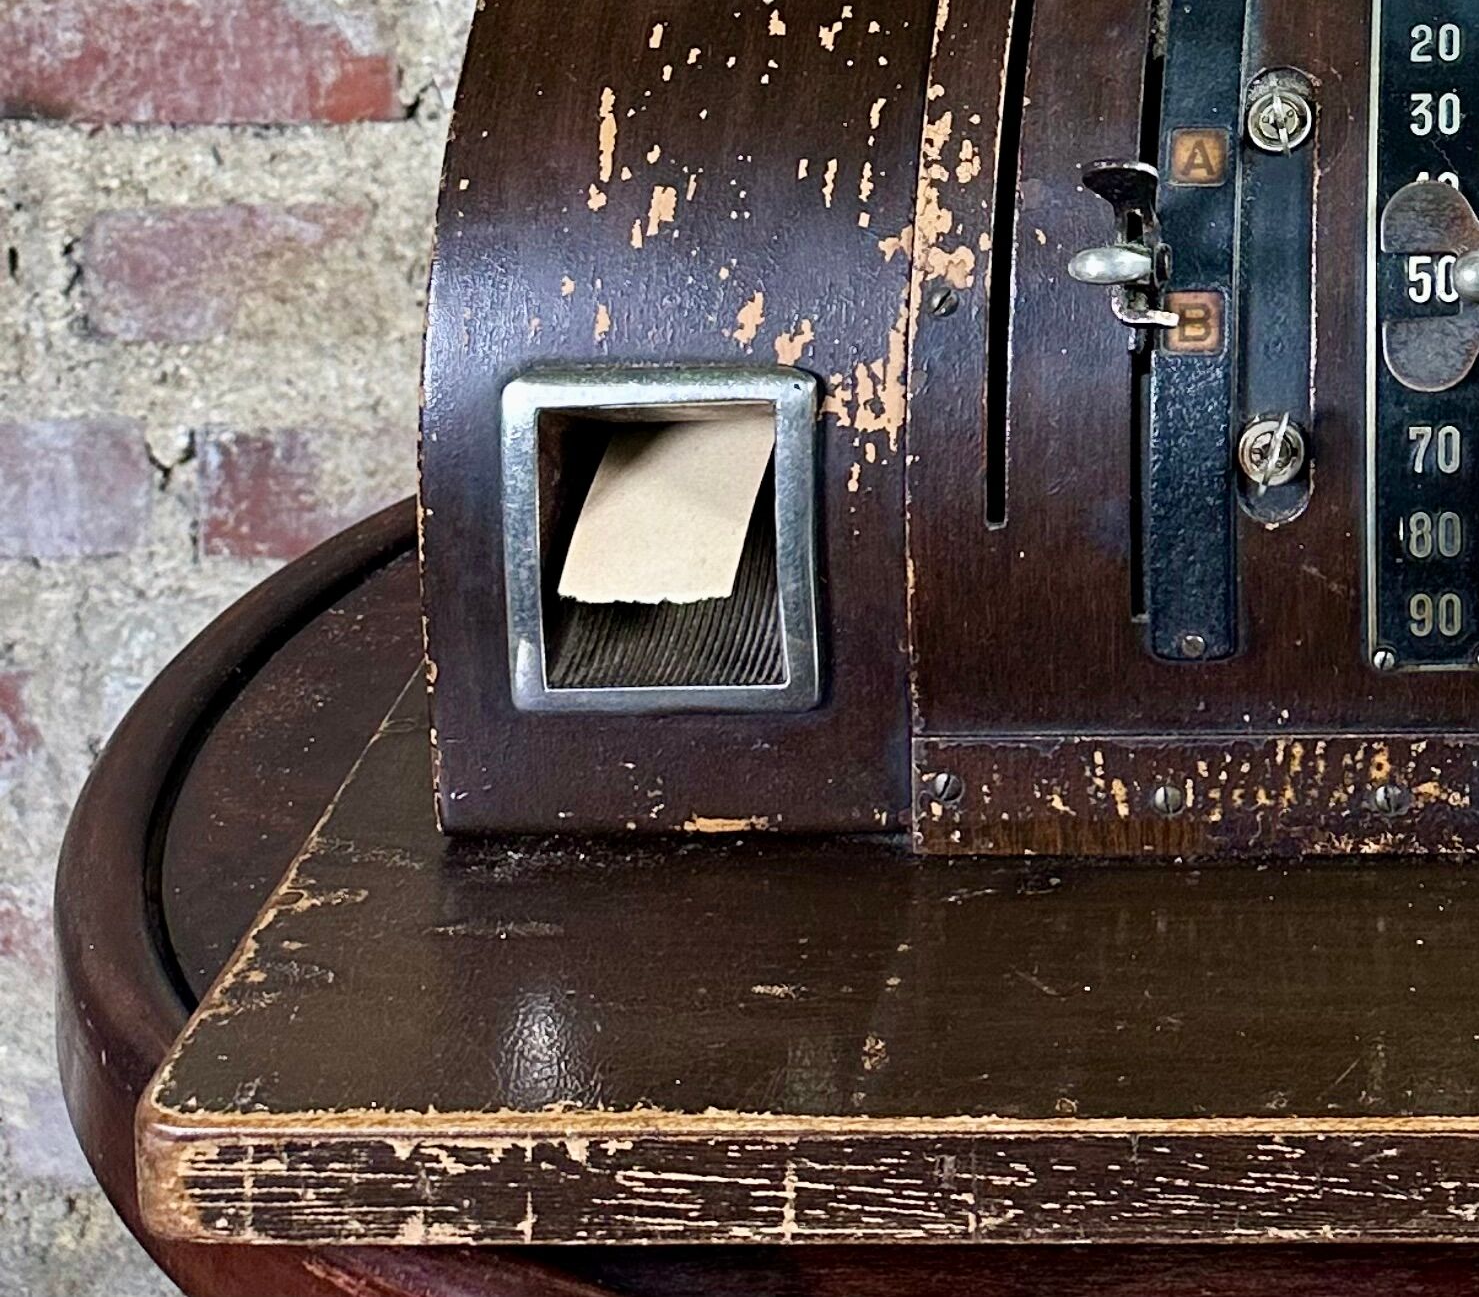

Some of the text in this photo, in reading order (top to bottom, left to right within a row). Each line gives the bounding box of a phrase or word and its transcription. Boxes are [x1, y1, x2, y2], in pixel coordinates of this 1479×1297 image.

[1410, 24, 1461, 62] 20
[1410, 93, 1461, 135] 30
[1181, 138, 1216, 177] A
[1178, 303, 1212, 342] B
[1409, 426, 1460, 474] 70
[1408, 511, 1462, 558] 80
[1409, 593, 1462, 637] 90
